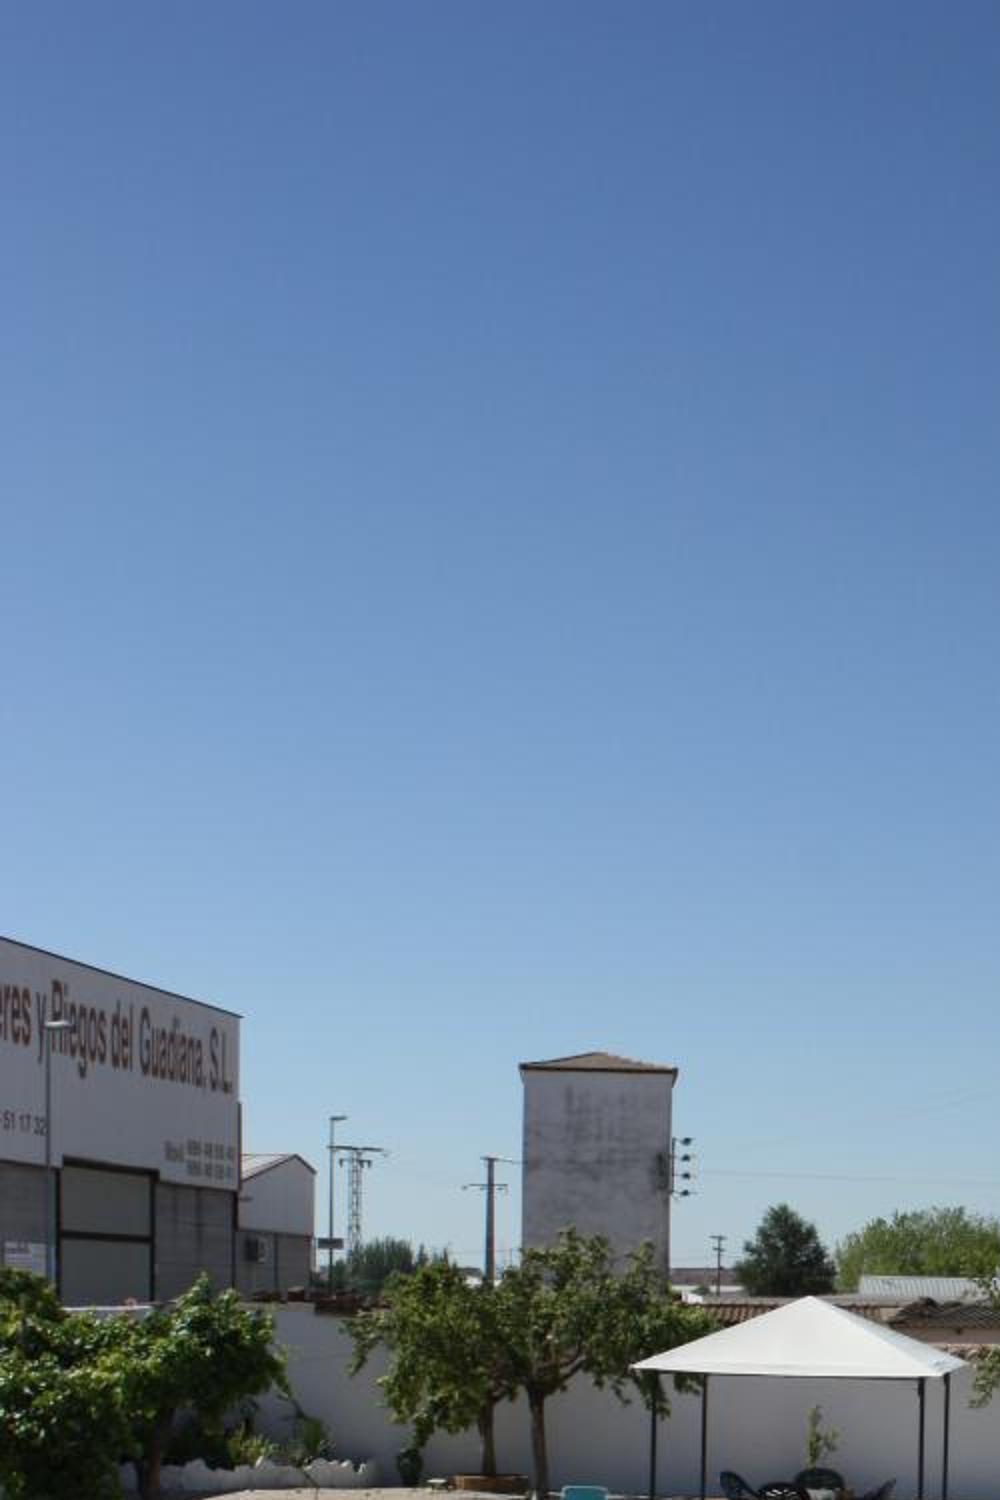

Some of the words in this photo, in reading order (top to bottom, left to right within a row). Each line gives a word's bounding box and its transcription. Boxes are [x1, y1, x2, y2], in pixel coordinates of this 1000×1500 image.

[0, 984, 31, 1047] res
[36, 992, 47, 1065] y
[51, 979, 107, 1079] Riegos
[111, 998, 134, 1073] del
[4, 1110, 15, 1130] 51
[19, 1114, 31, 1133] 17
